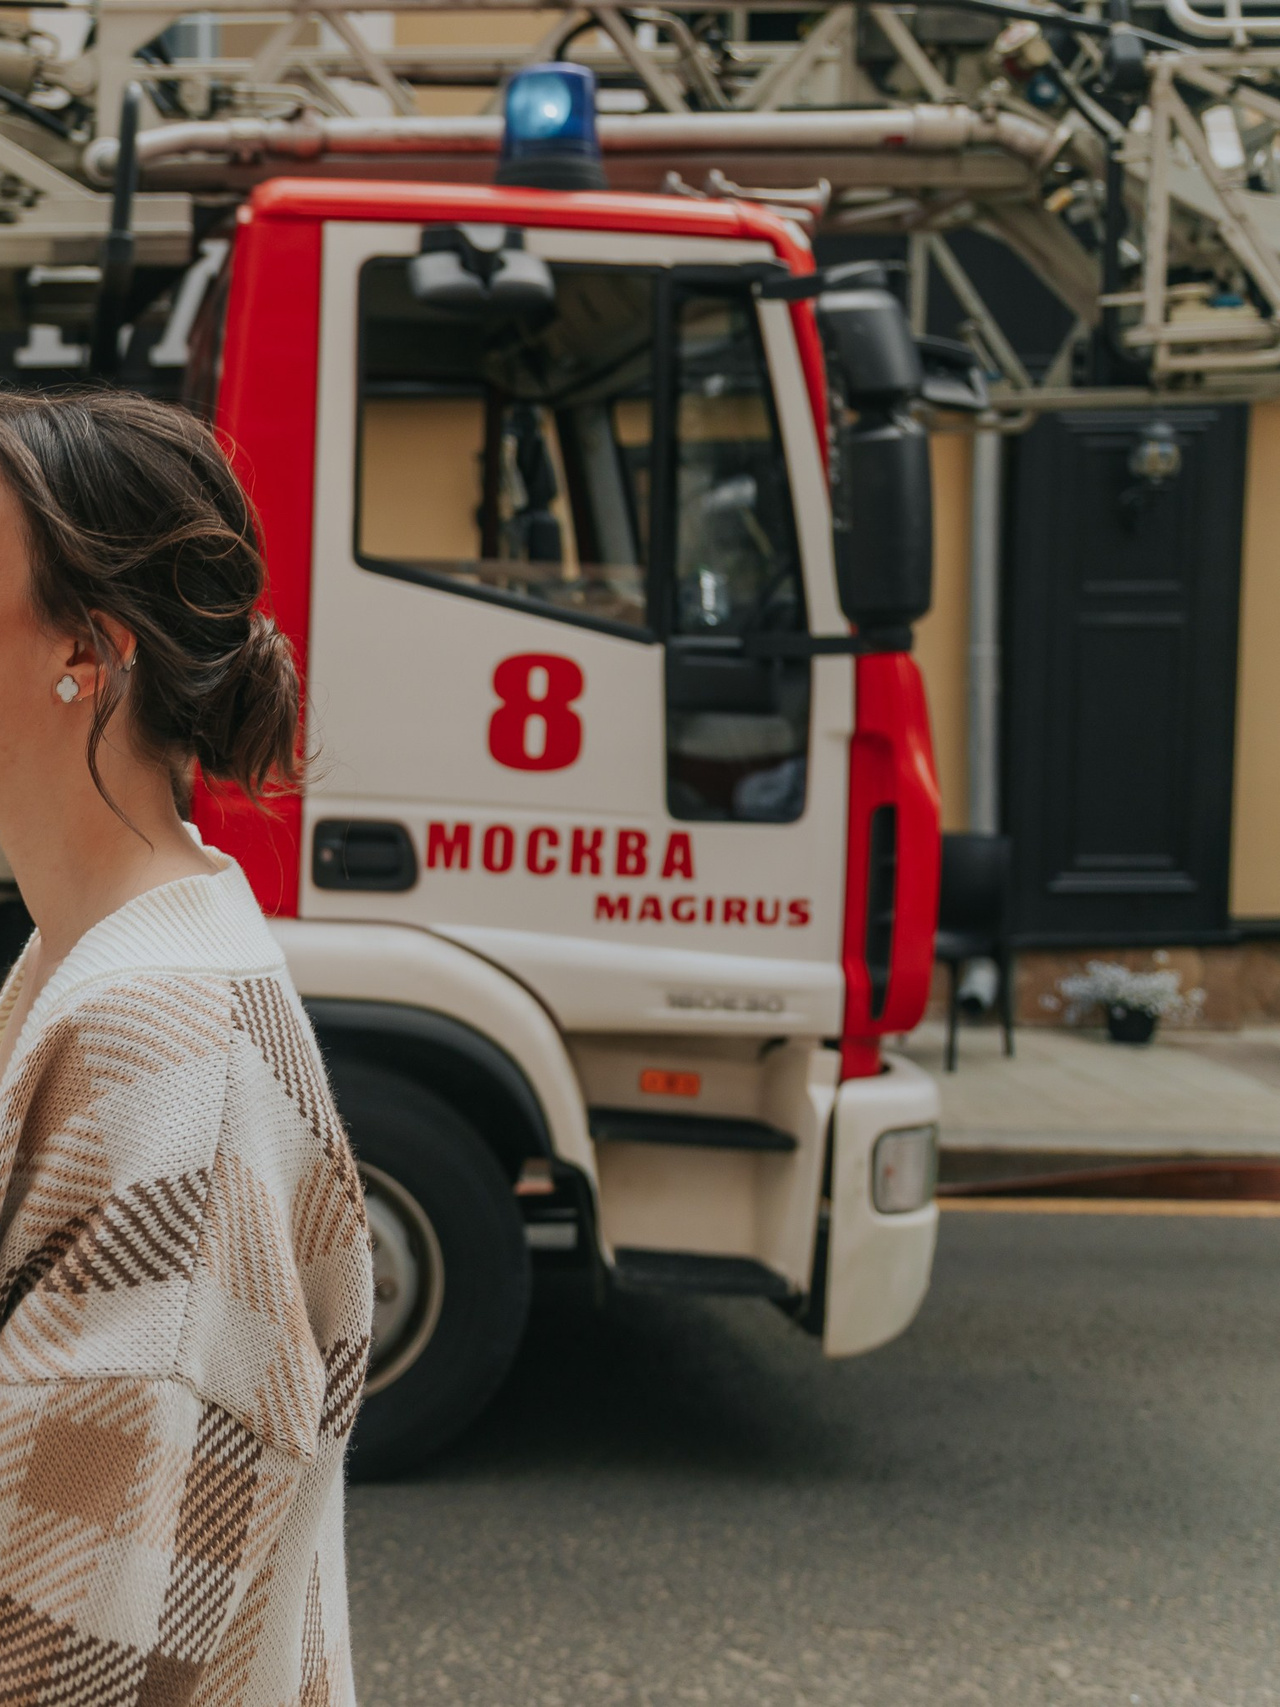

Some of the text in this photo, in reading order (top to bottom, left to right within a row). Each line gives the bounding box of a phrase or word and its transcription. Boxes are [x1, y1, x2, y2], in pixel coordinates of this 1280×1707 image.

[488, 653, 584, 771] 8
[426, 821, 694, 880] МОСКВА
[595, 894, 812, 927] MAGIRUS
